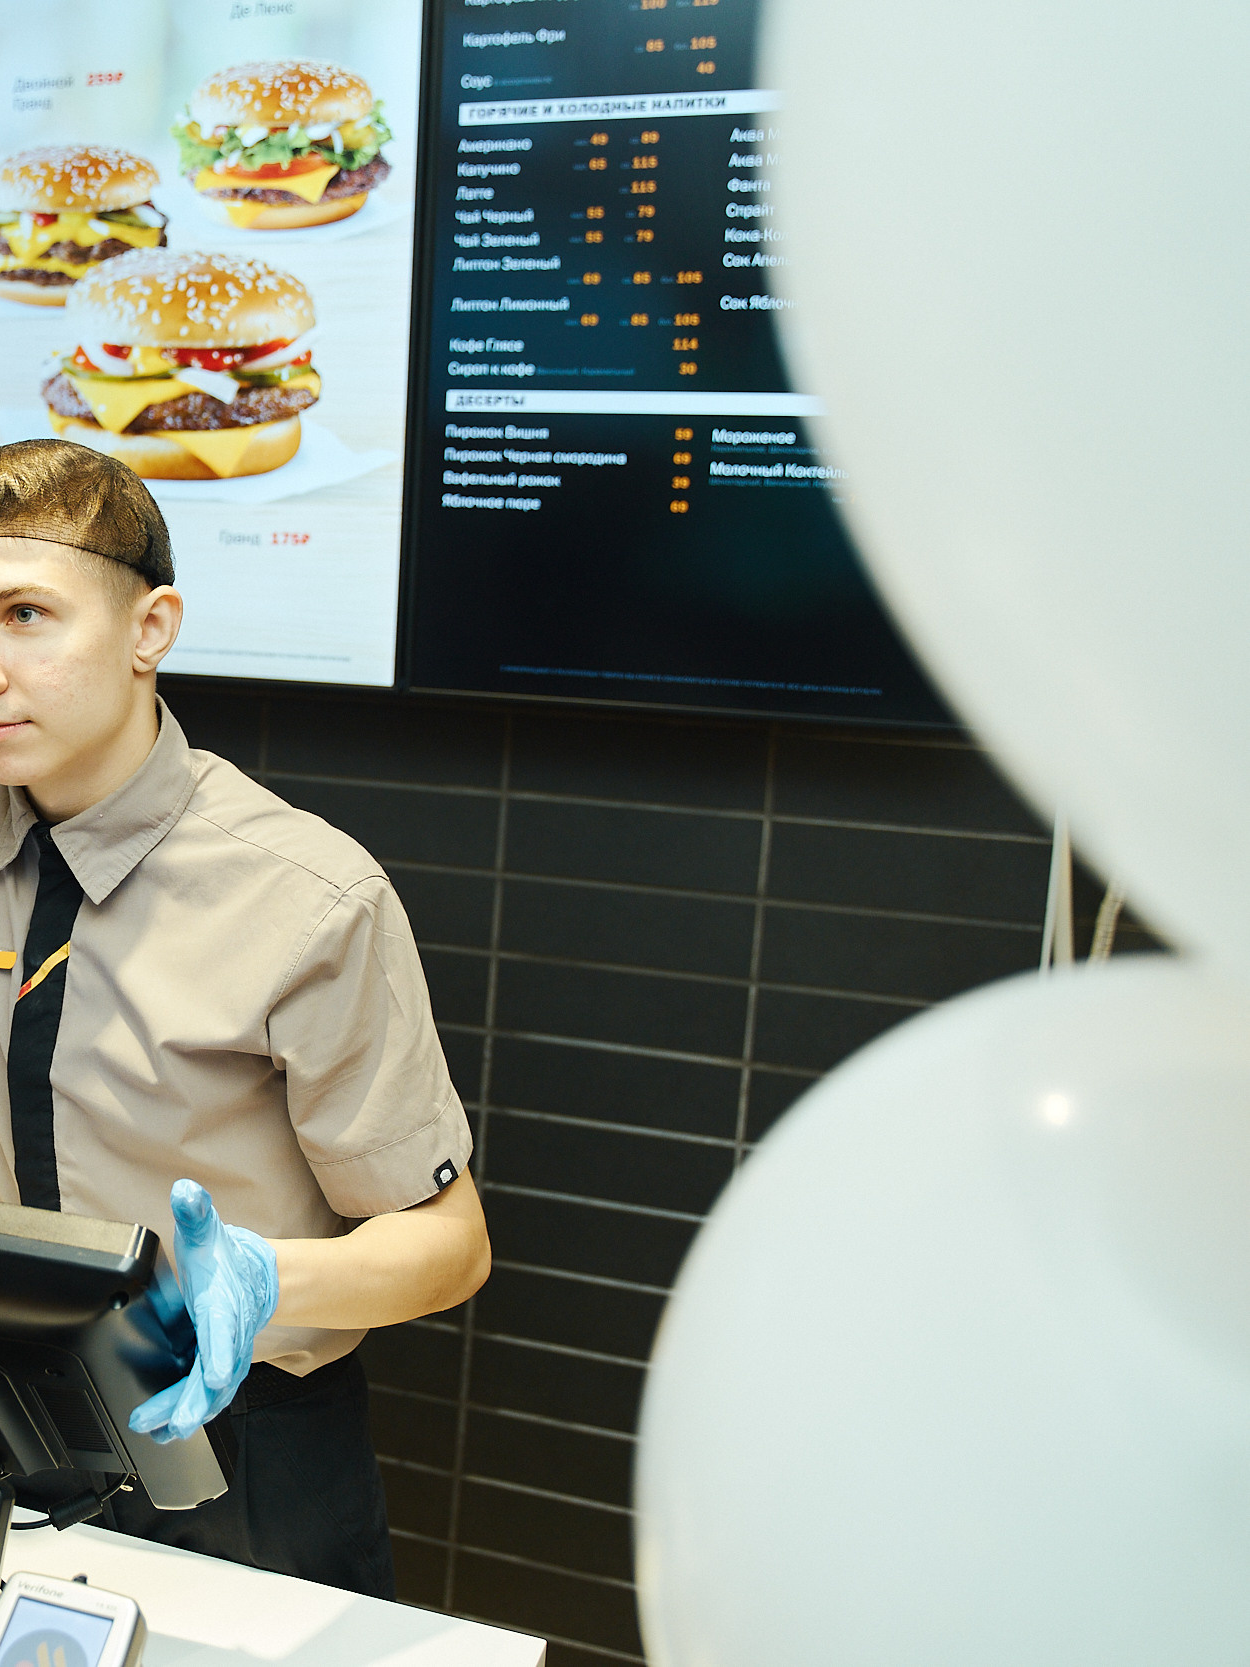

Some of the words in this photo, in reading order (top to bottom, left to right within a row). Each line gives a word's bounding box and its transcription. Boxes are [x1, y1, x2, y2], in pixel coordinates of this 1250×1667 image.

[535, 28, 567, 44] Фри
[461, 73, 494, 91] Соус
[468, 104, 538, 120] ГОРЯЧИЕ
[543, 104, 553, 115] И
[555, 99, 647, 117] ХОЛОДНЫЕ
[652, 96, 727, 111] НАПИТКИ
[457, 137, 533, 154] Американо
[454, 209, 482, 225] Чай
[482, 207, 535, 225] Черный
[453, 233, 481, 248] Чай
[481, 231, 541, 248] Зеленый
[501, 254, 562, 271] Зеленый
[723, 251, 751, 268] Сок
[720, 294, 749, 311] Сок
[449, 338, 485, 354] Кофе
[448, 361, 489, 378] Сироп
[500, 361, 536, 378] кофе
[455, 394, 525, 408] ДЕСЕРТЫ
[711, 428, 797, 445] Мороженое
[709, 461, 784, 477] Молочный
[17, 1580, 65, 1599] Verifone
